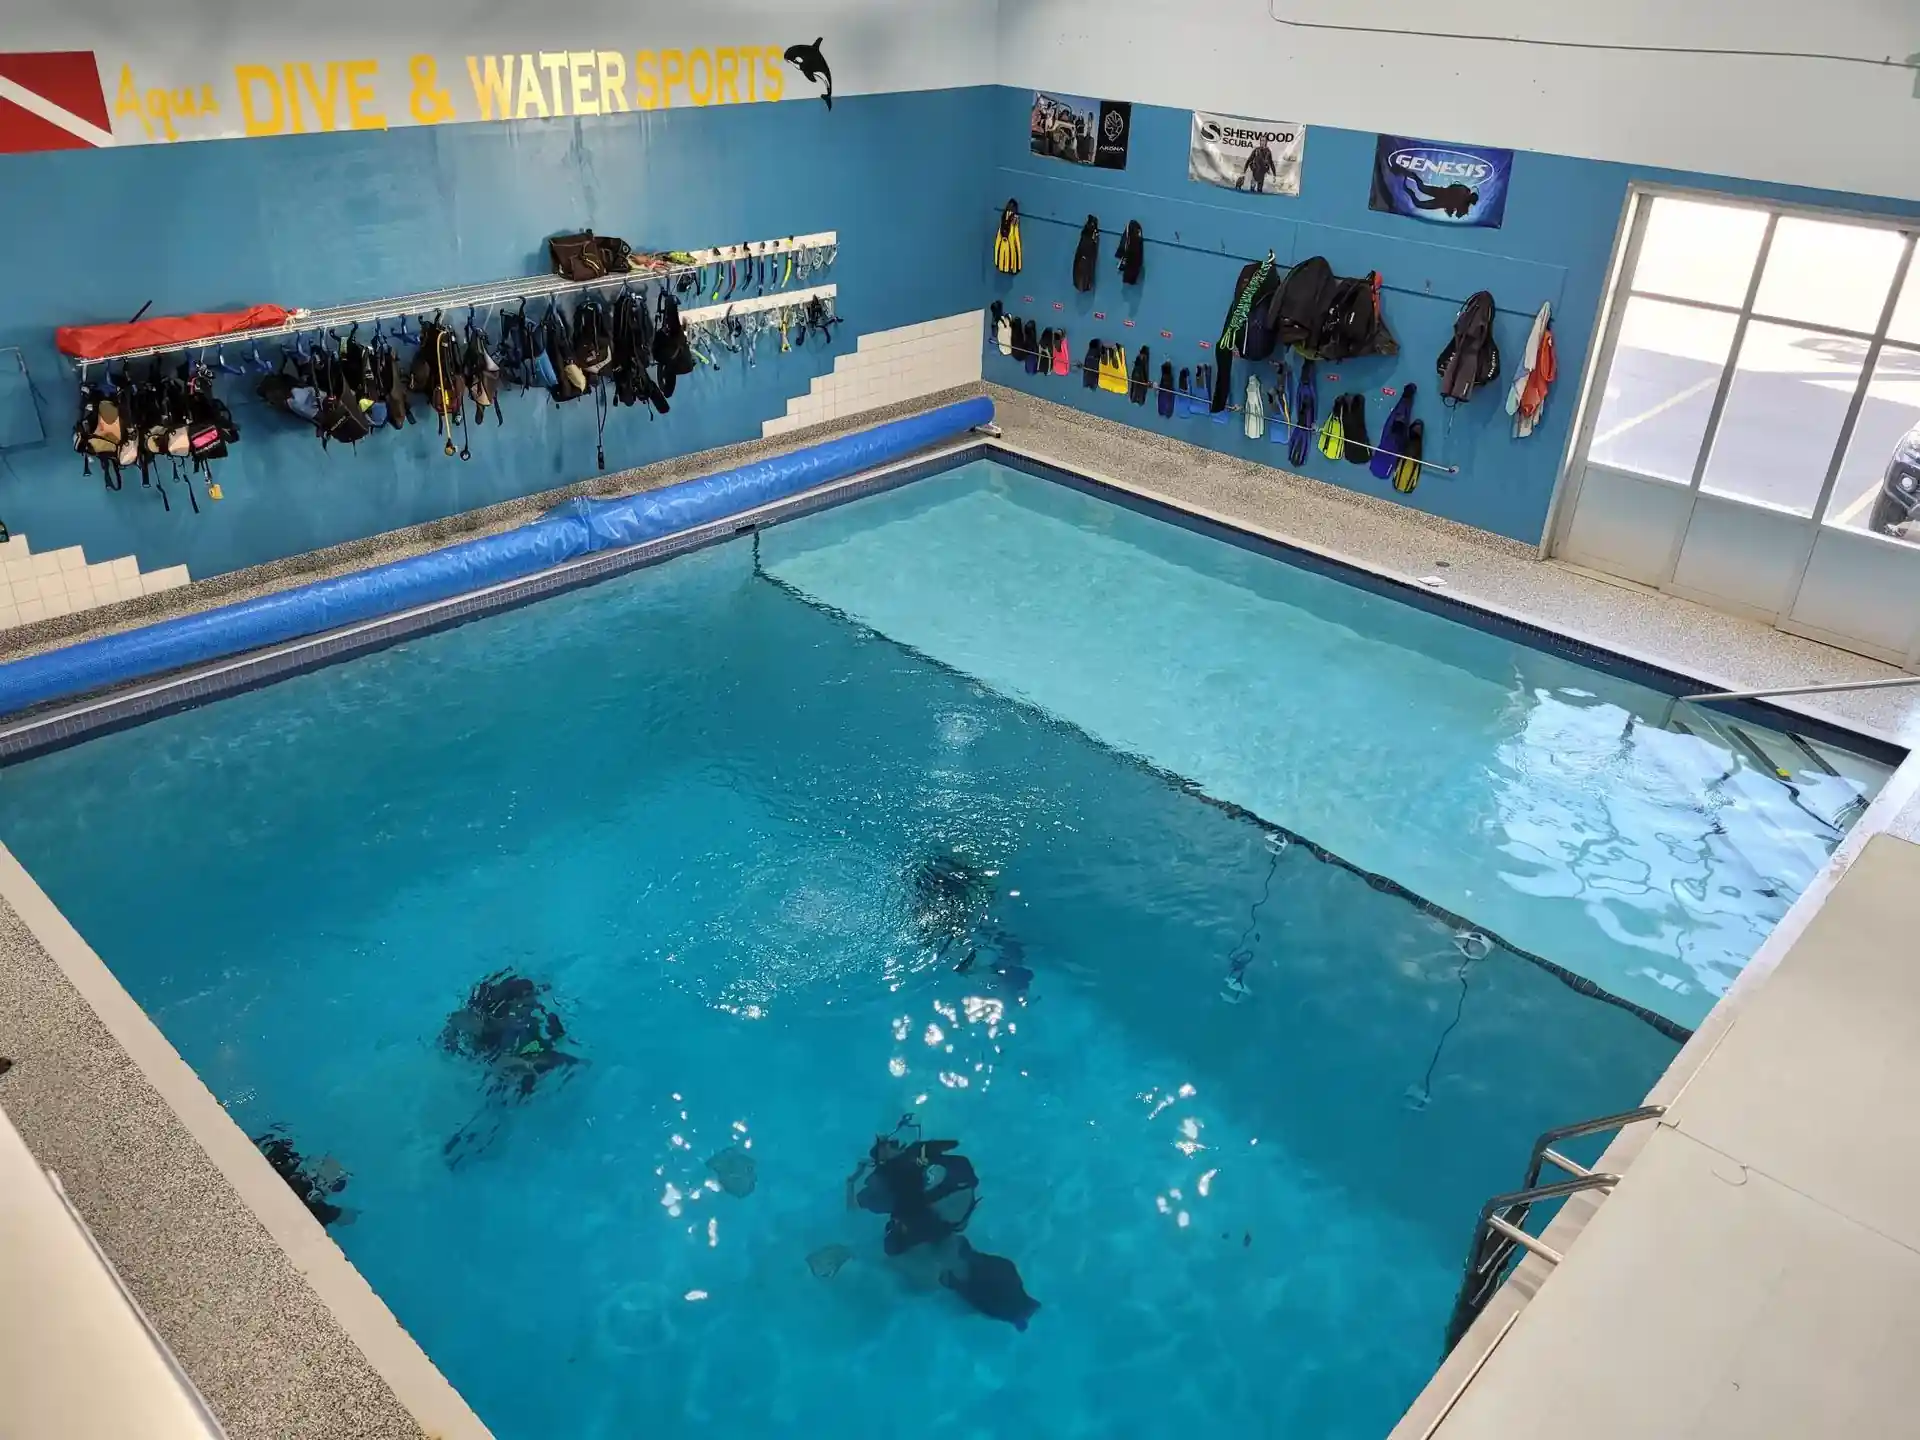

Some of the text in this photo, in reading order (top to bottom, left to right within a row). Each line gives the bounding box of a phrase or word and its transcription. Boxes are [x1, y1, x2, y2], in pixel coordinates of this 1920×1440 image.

[234, 58, 387, 138] DIVE
[408, 53, 456, 126] &
[1222, 138, 1253, 149] SCUBA
[1223, 127, 1294, 142] SHERWOOD
[1395, 154, 1487, 178] GENESIS
